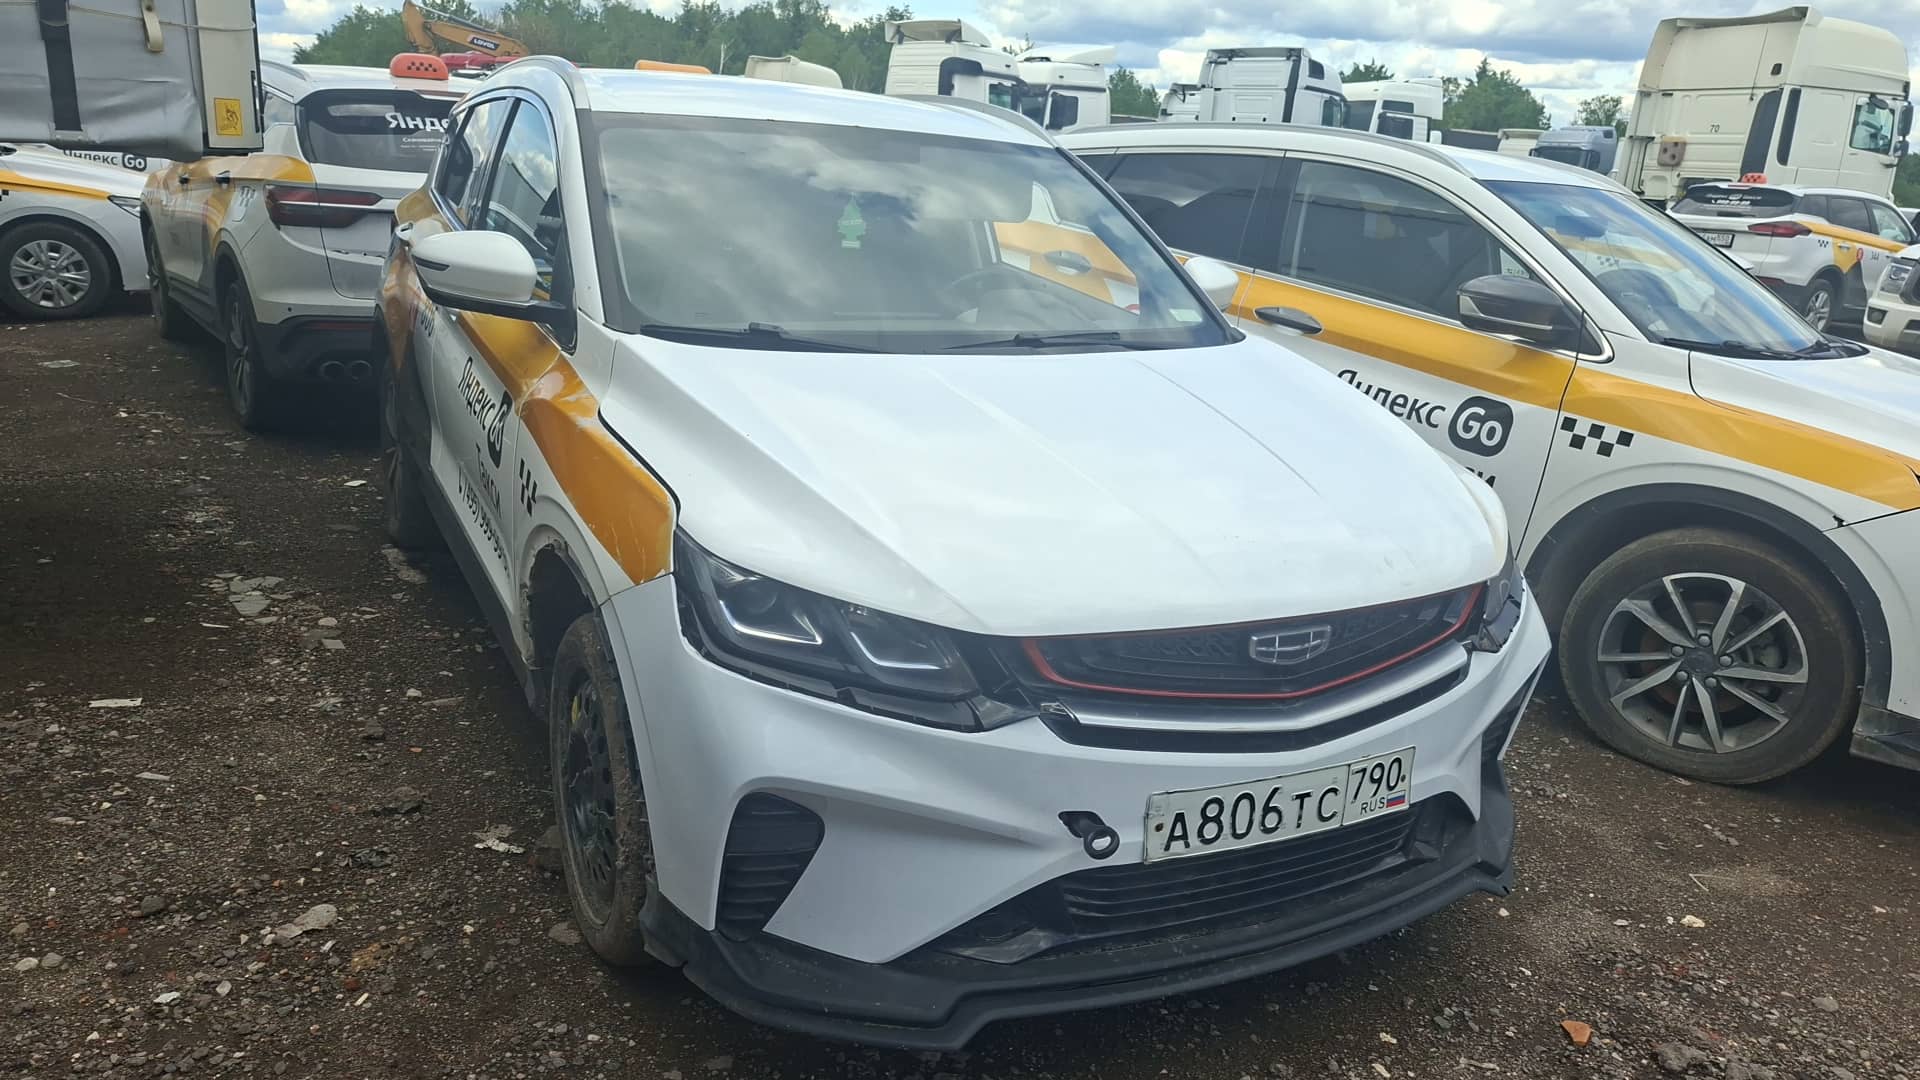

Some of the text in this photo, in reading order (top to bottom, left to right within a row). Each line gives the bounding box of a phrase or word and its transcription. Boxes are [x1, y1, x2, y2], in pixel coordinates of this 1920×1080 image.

[124, 154, 145, 169] Go
[458, 356, 496, 431] Яндекс
[1456, 406, 1503, 447] Go
[1164, 757, 1402, 852] А806ТС 790
[1361, 797, 1385, 815] RUS
